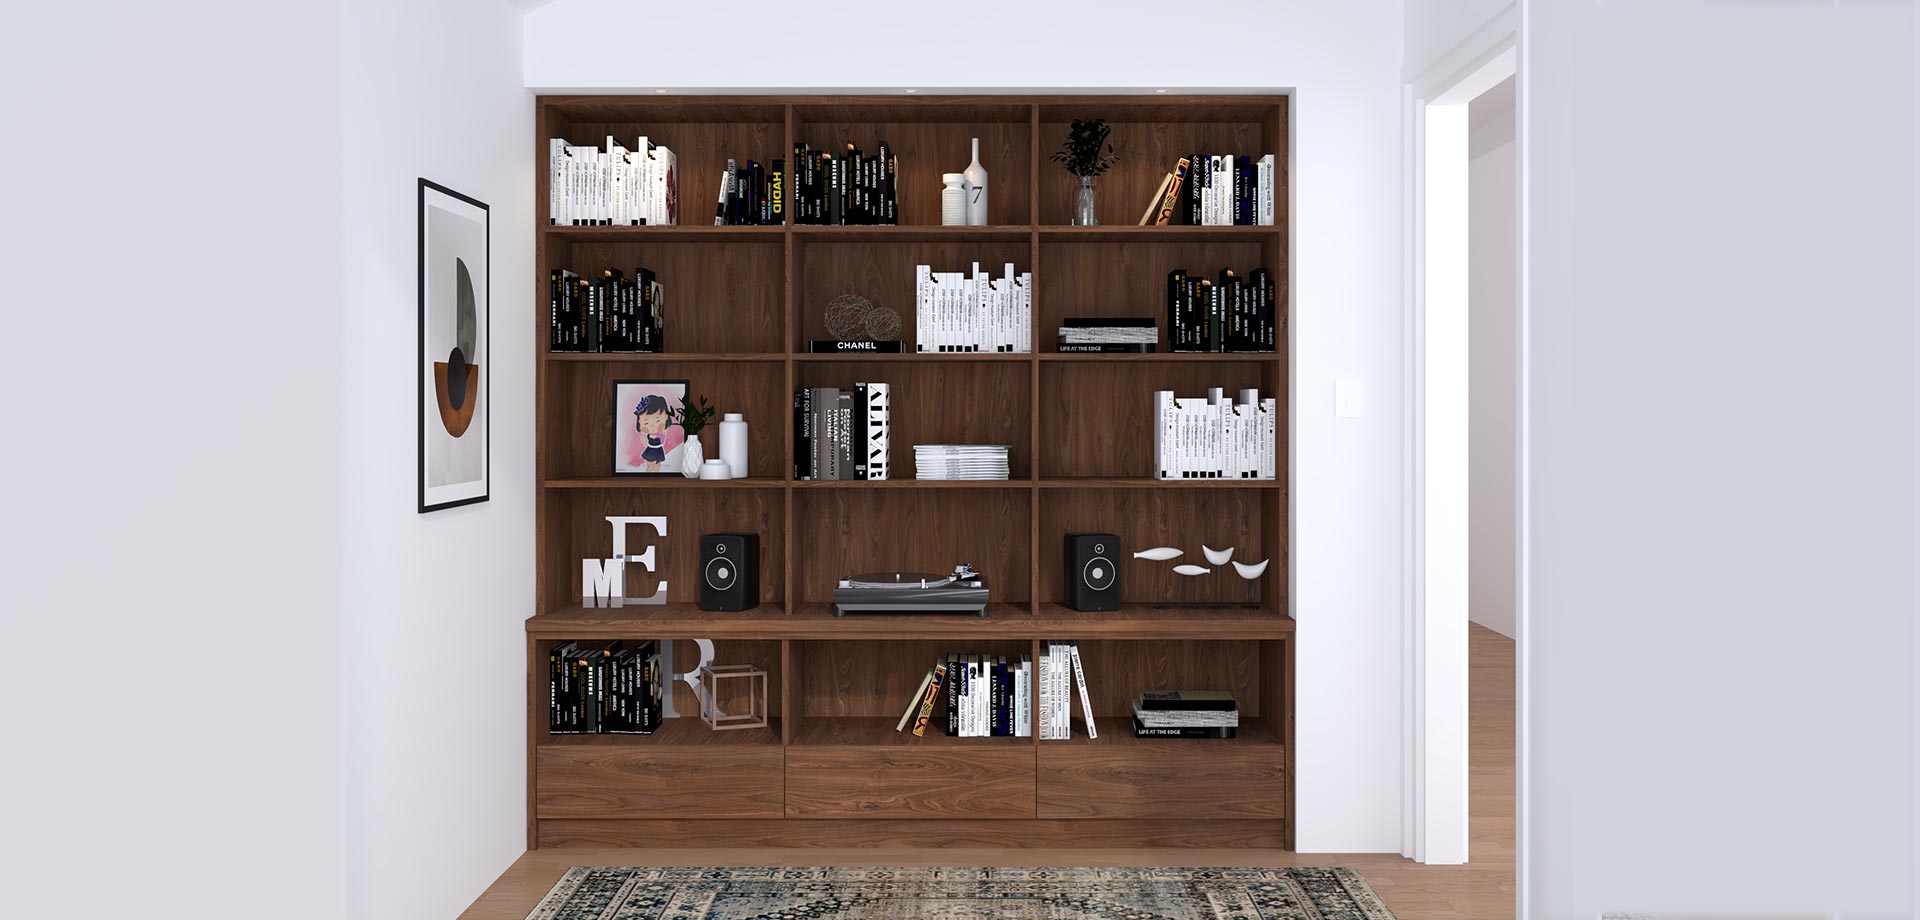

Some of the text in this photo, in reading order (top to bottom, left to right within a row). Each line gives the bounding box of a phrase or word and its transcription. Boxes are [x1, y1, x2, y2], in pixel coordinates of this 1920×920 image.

[972, 186, 983, 204] 7
[870, 385, 883, 478] ALIVAR
[582, 558, 623, 608] M
[605, 516, 667, 605] E
[1072, 654, 1081, 670] pierre
